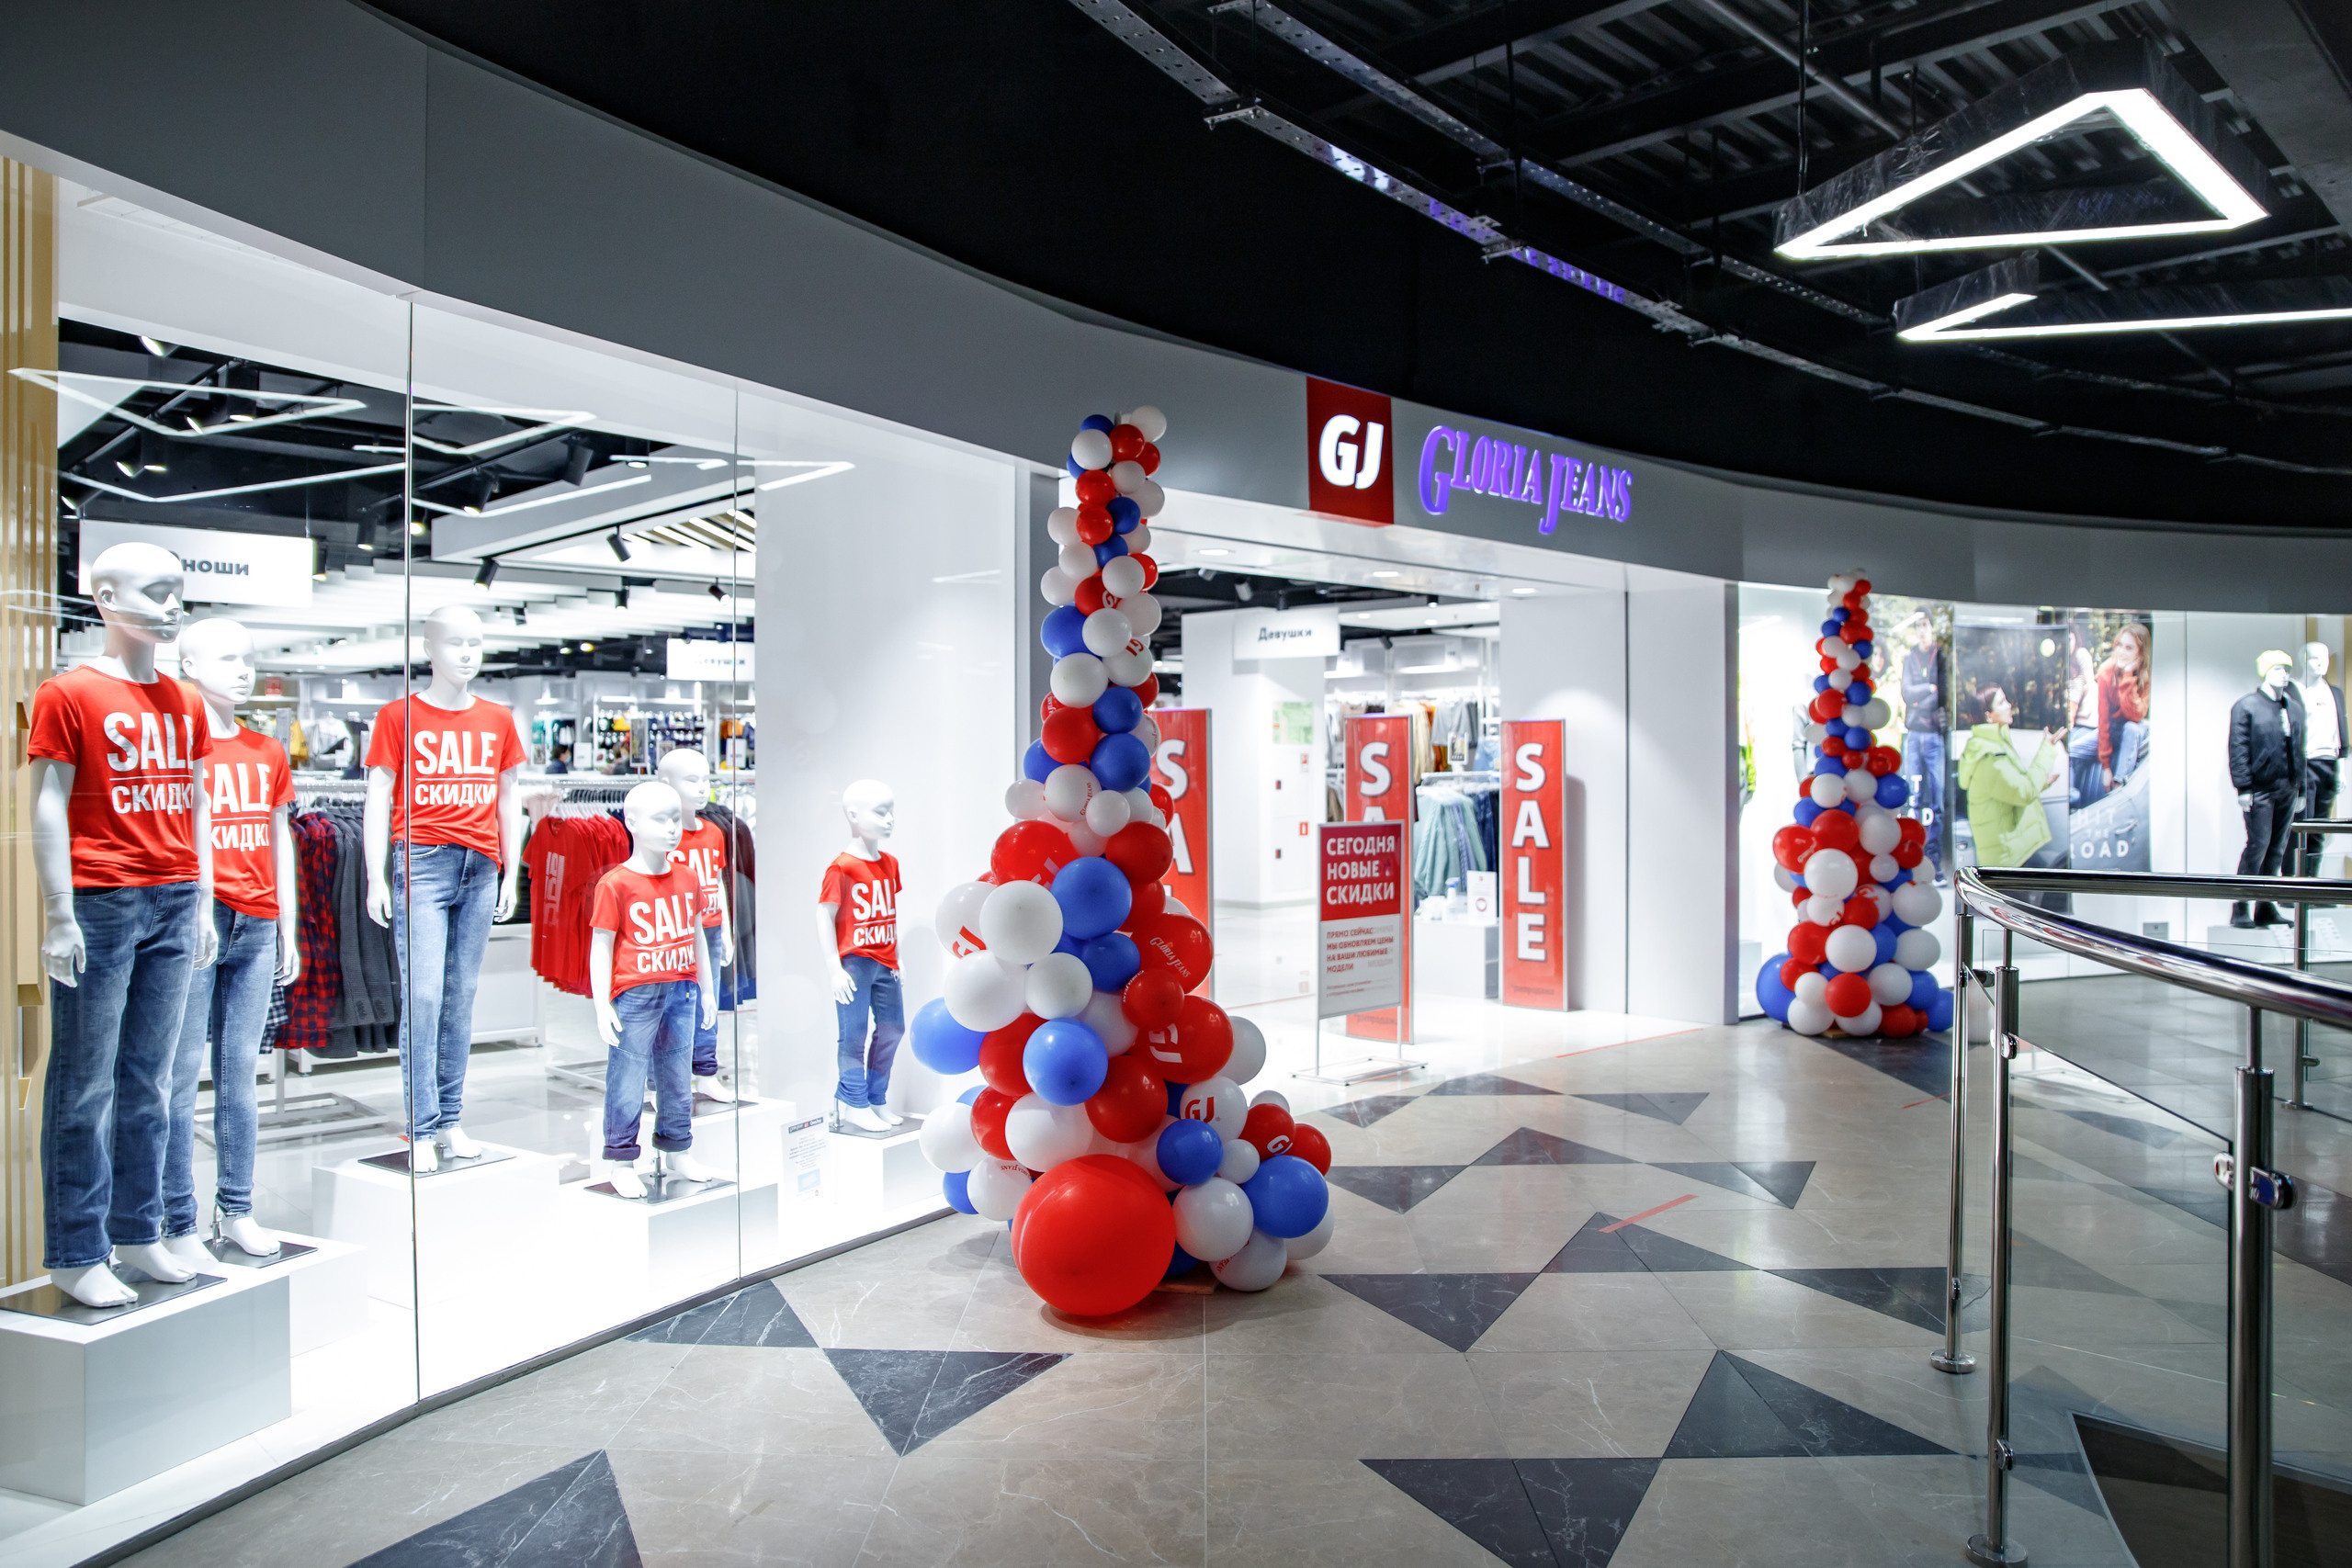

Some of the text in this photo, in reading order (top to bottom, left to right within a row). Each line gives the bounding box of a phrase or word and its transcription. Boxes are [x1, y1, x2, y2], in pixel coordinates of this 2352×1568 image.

[1319, 414, 1384, 490] GJ
[168, 550, 249, 576] ноши
[1258, 627, 1312, 642] Девушки
[413, 730, 496, 775] SALE
[111, 783, 193, 815] СКИДК
[414, 784, 497, 808] СКИДКИ
[210, 824, 269, 852] КИДК
[1326, 835, 1396, 856] СЕГОДНЯ
[1511, 742, 1551, 962] SALE
[1327, 860, 1380, 880] НОВЫЕ
[851, 878, 897, 920] SAL
[1326, 882, 1395, 906] СКИДКИ
[629, 892, 695, 945] SALE
[1327, 930, 1349, 939] ПРЯМО
[1350, 927, 1374, 937] СЕЙЧАС
[1327, 932, 1394, 951] МЫ ОБНОВЛЯЕМ ЦЕНЫ
[1327, 947, 1388, 962] НА ВАШИ ЛЮБИМЫЕ
[1327, 963, 1353, 974] МОДЕЛИ
